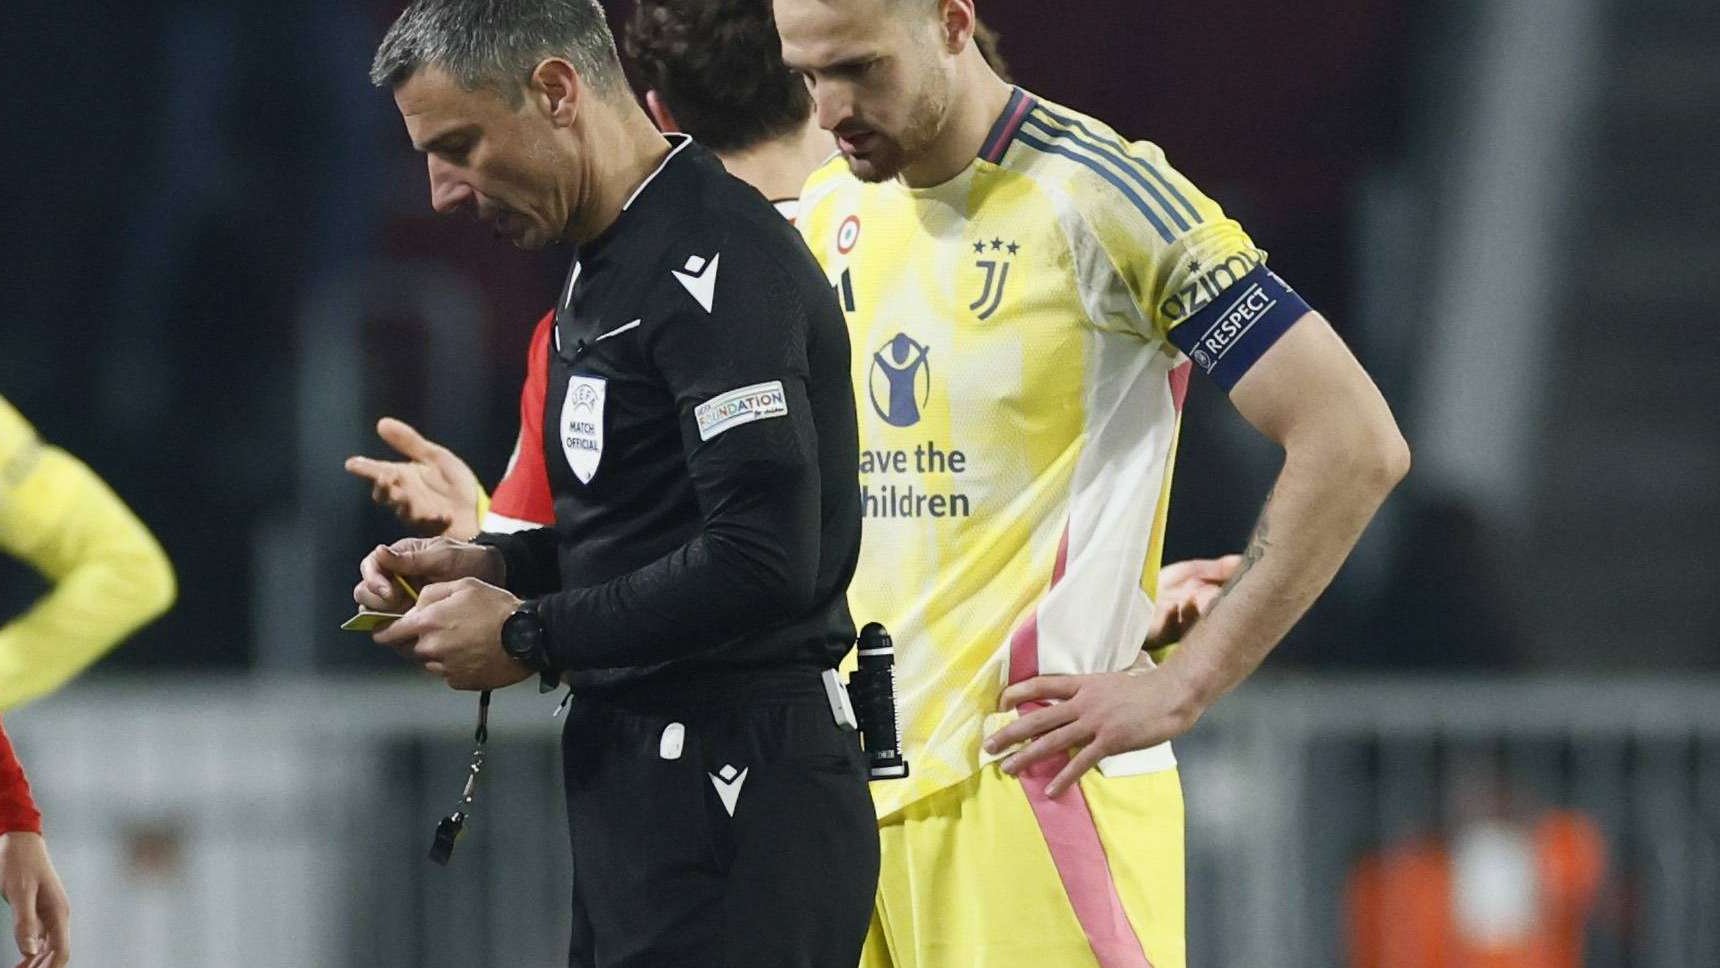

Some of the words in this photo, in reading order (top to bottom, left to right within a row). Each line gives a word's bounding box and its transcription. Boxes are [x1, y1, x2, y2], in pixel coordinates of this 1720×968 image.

[1161, 251, 1261, 319] azimu
[1205, 287, 1270, 354] RESPECT
[698, 392, 783, 426] FOUNDATION
[566, 437, 598, 451] OFFICIAL
[569, 421, 595, 434] MATCH
[859, 450, 907, 474] ave
[914, 441, 966, 474] the
[861, 485, 970, 518] hildren
